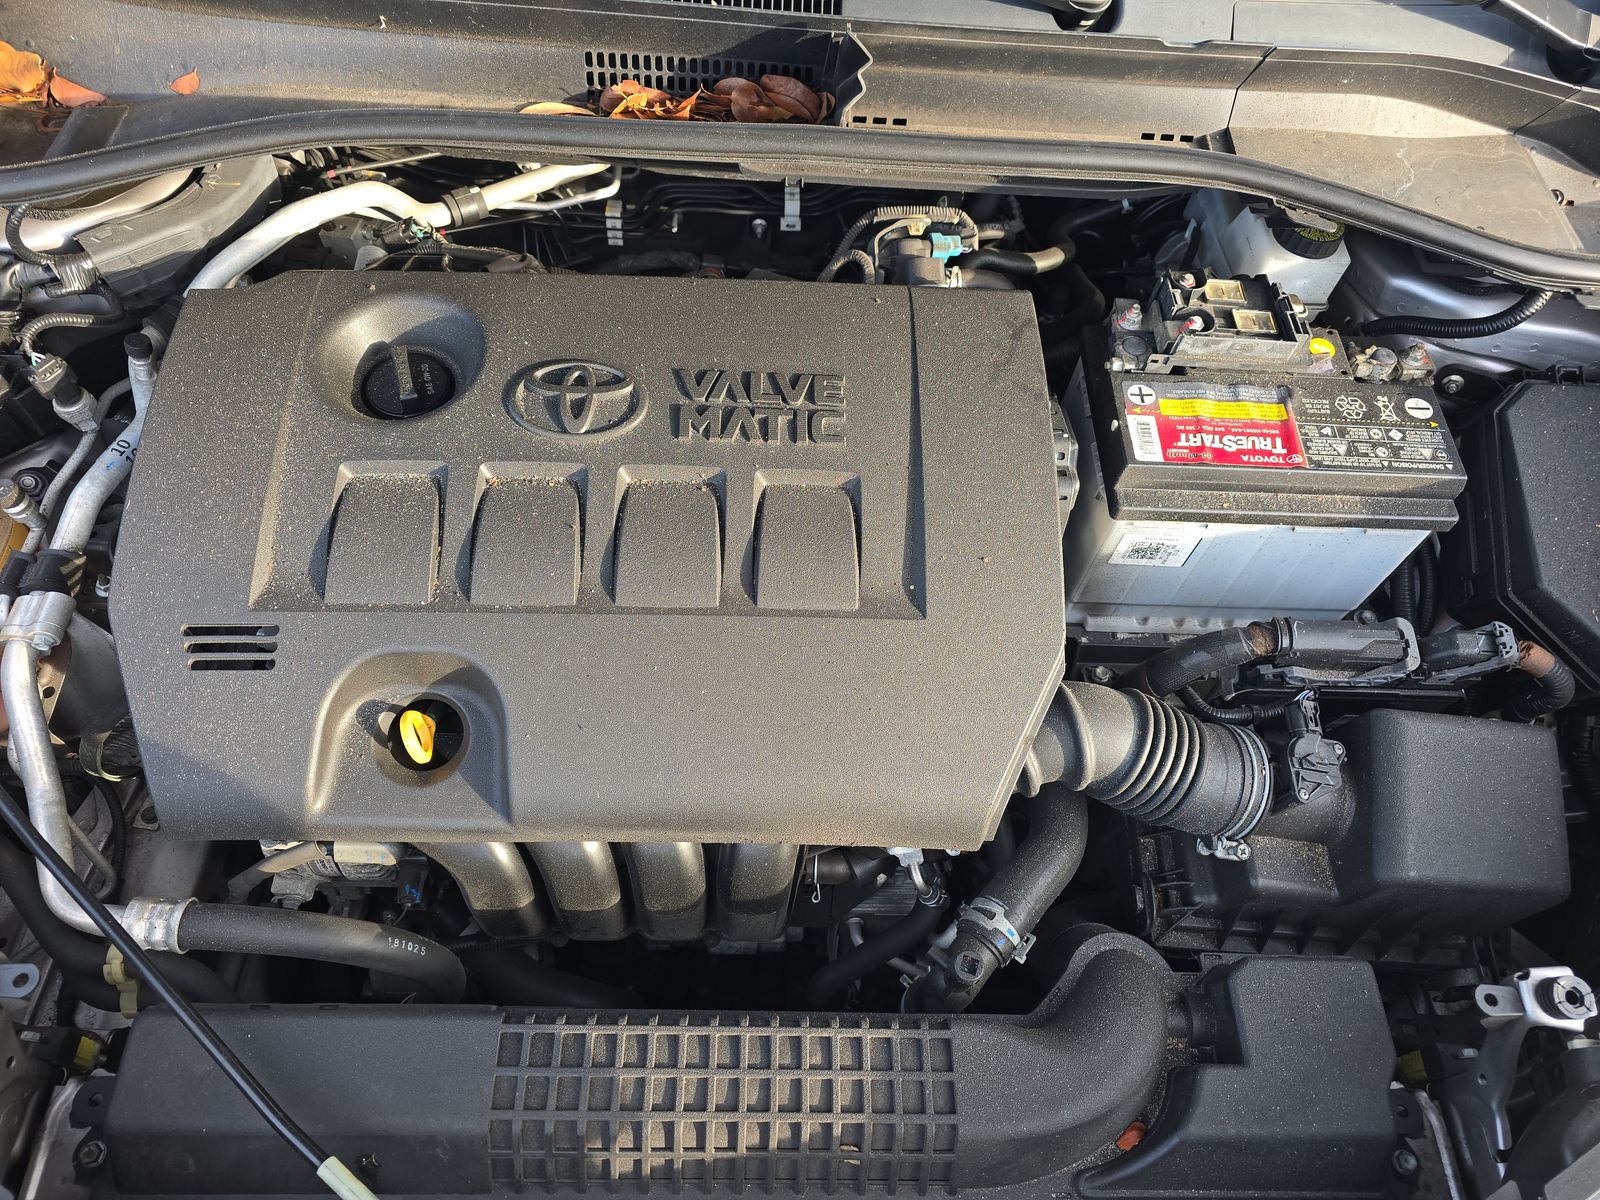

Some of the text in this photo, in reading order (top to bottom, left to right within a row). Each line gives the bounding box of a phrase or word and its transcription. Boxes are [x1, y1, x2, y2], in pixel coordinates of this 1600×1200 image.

[425, 382, 435, 395] SAE
[670, 368, 846, 407] VALVE
[669, 403, 847, 446] MATIC
[110, 439, 131, 457] 10
[1240, 455, 1285, 463] TOYOTA
